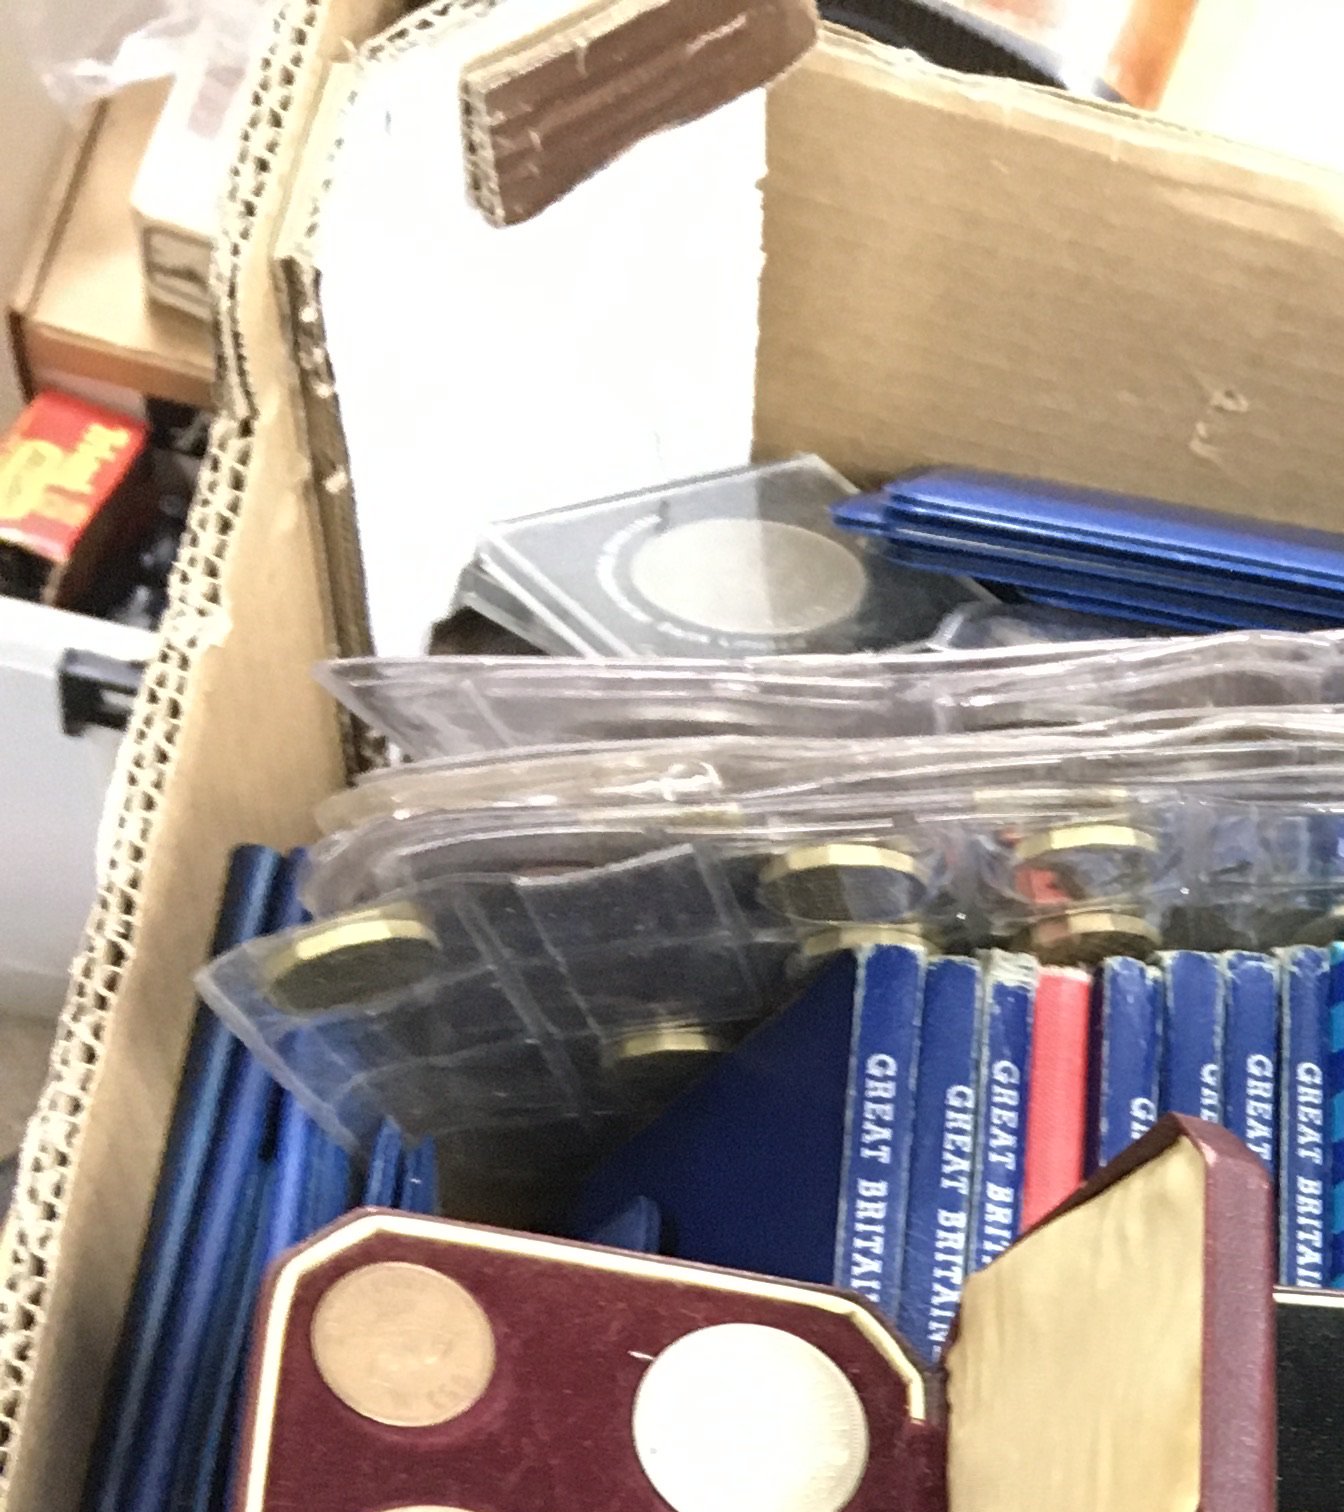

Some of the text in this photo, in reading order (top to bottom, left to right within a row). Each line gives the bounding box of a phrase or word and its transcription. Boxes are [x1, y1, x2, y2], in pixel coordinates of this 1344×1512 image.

[940, 1084, 975, 1195] GREAT
[988, 1060, 1021, 1171] GREAT
[1246, 1053, 1274, 1160] GREAT
[1296, 1062, 1323, 1165] GREAT
[850, 1053, 897, 1302] GREAT BRITAI
